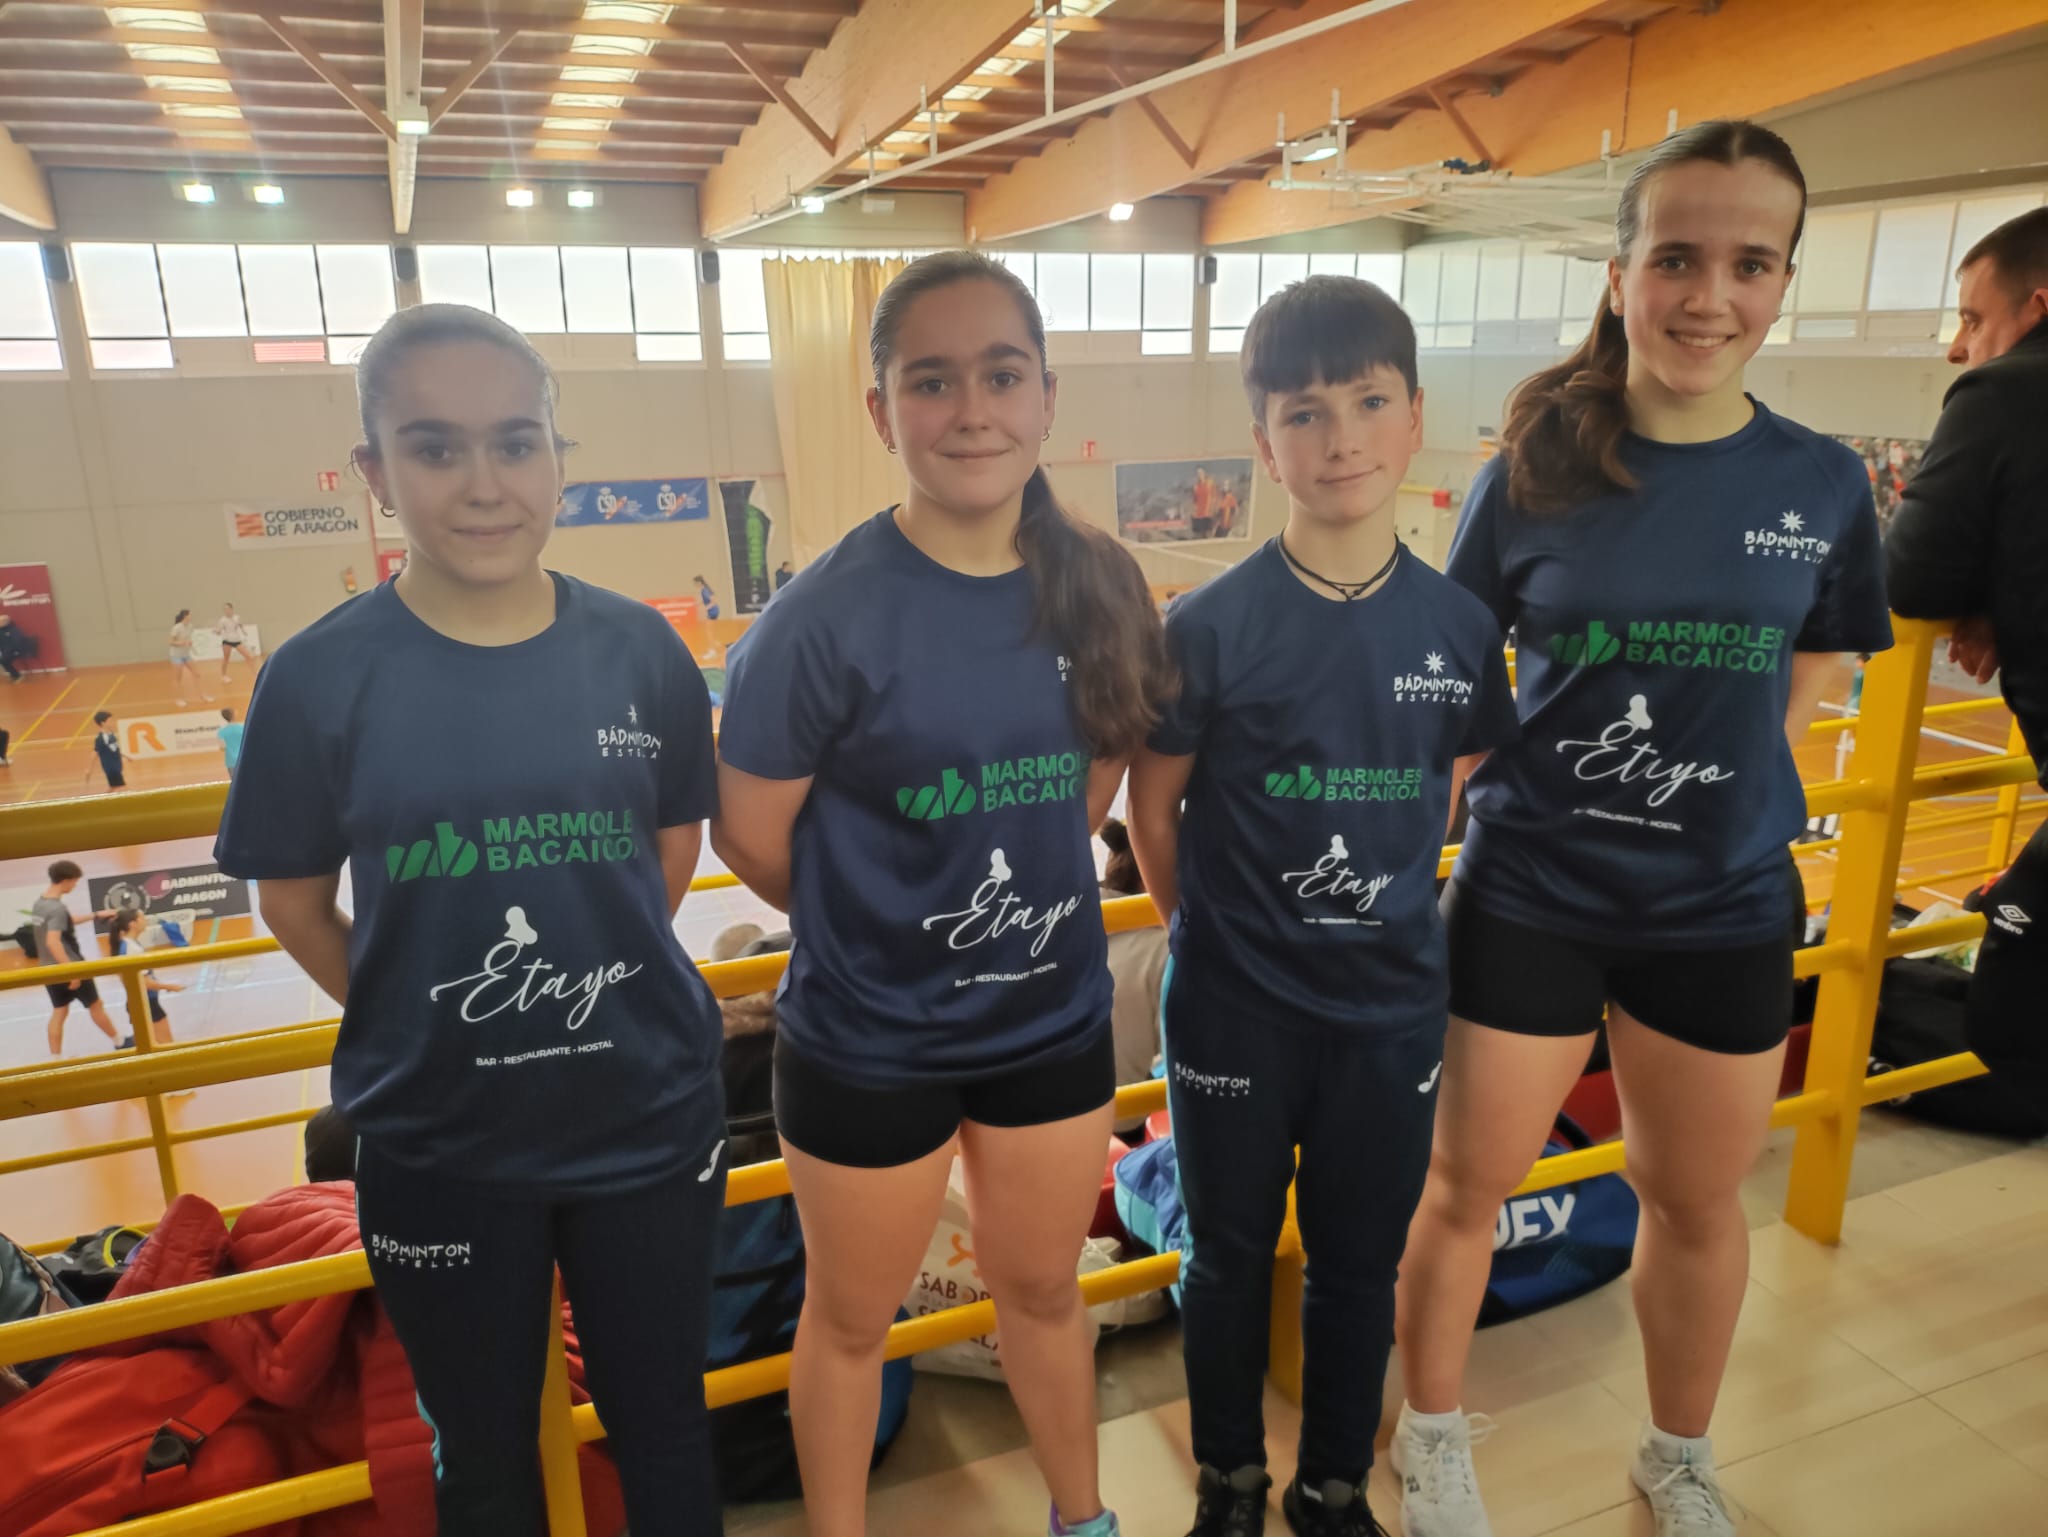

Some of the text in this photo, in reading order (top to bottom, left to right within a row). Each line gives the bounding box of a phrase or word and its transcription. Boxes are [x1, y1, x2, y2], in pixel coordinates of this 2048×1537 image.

[264, 506, 345, 523] GOBIERNO
[266, 519, 359, 536] DE ARAGON
[1626, 621, 1785, 650] MARMOLES
[1625, 643, 1779, 674] BACAICOA
[1393, 672, 1473, 695] BÁDMINTON
[1326, 768, 1423, 785] MARMOLES
[1325, 785, 1421, 801] BACAICOA
[483, 809, 633, 844] MARMOLE
[486, 837, 638, 873] BACAICO
[173, 888, 228, 906] ARAGON
[922, 878, 1083, 958] Etayo
[430, 939, 643, 1030] Etayo
[476, 1039, 614, 1066] BAR RESTAURANTE HOSTAL
[371, 1234, 471, 1259] BÁDMINTON
